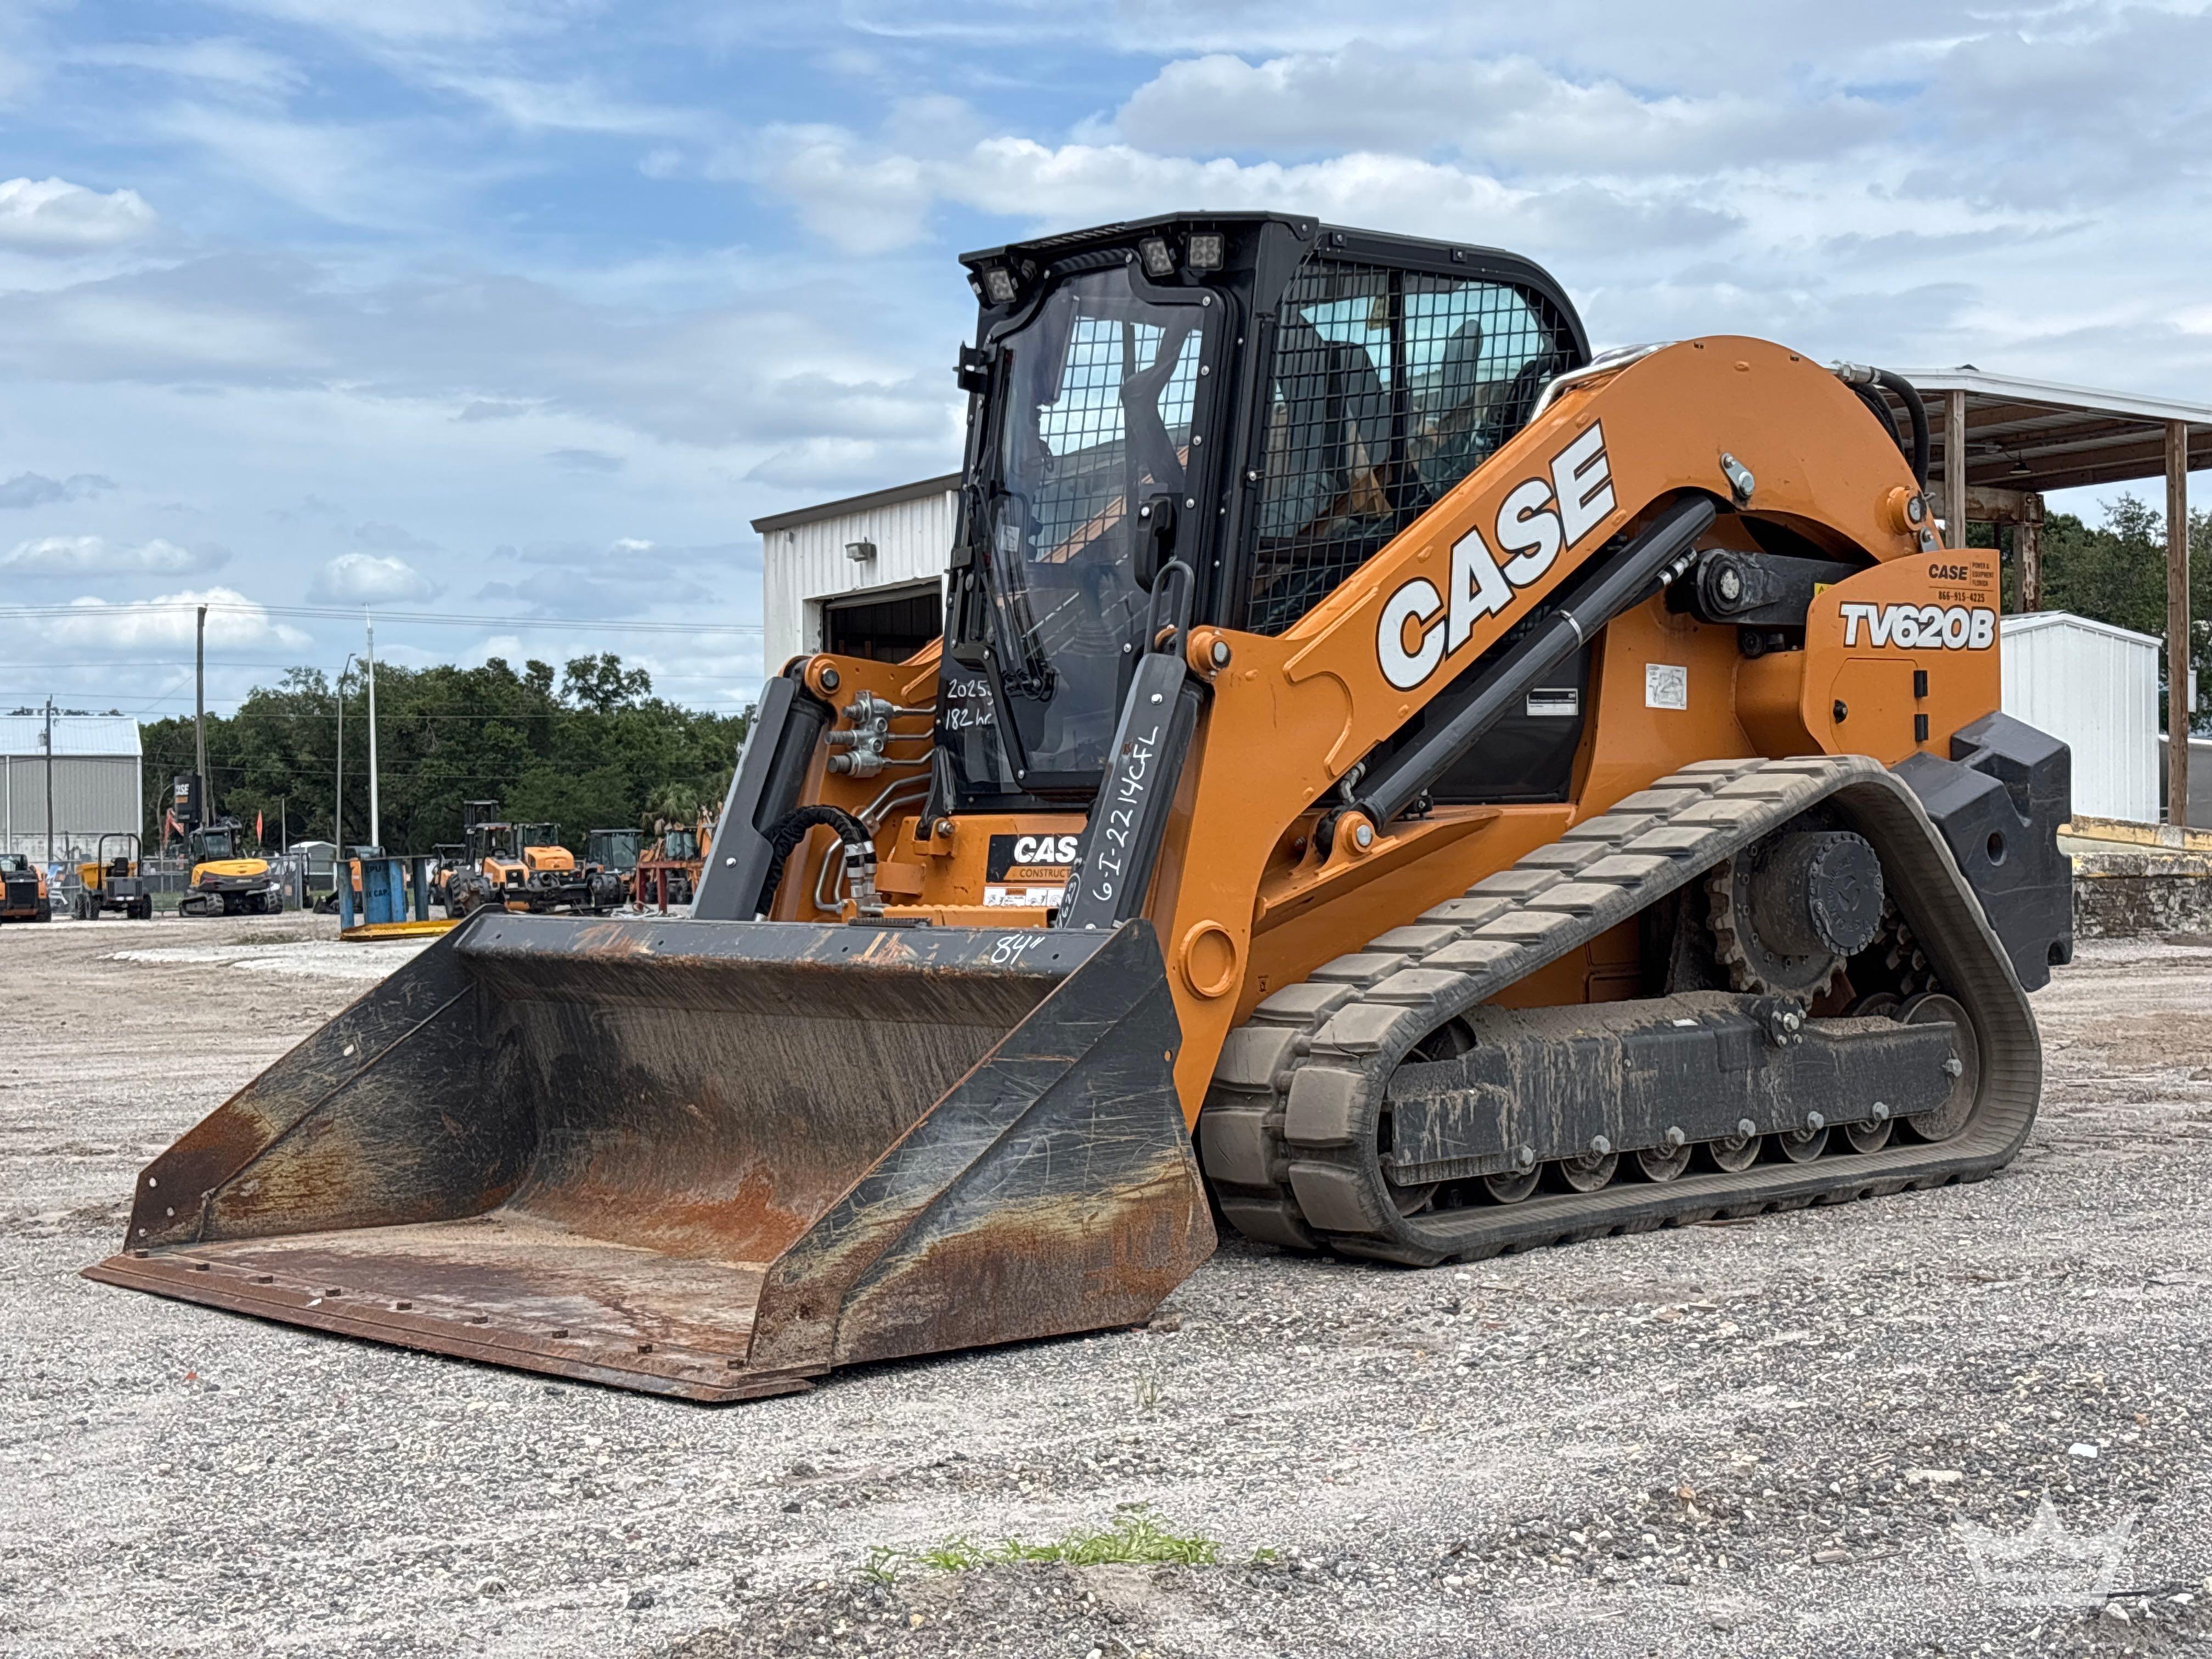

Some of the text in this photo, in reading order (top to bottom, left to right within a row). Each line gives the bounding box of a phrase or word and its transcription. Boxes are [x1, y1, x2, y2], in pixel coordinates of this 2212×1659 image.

[1376, 417, 1618, 692] CASE
[1928, 563, 1968, 580] CASE
[1838, 601, 1996, 651] TV620B
[946, 708, 974, 730] 182
[1014, 836, 1078, 863] CAS
[1020, 868, 1071, 878] CONSTRUCT
